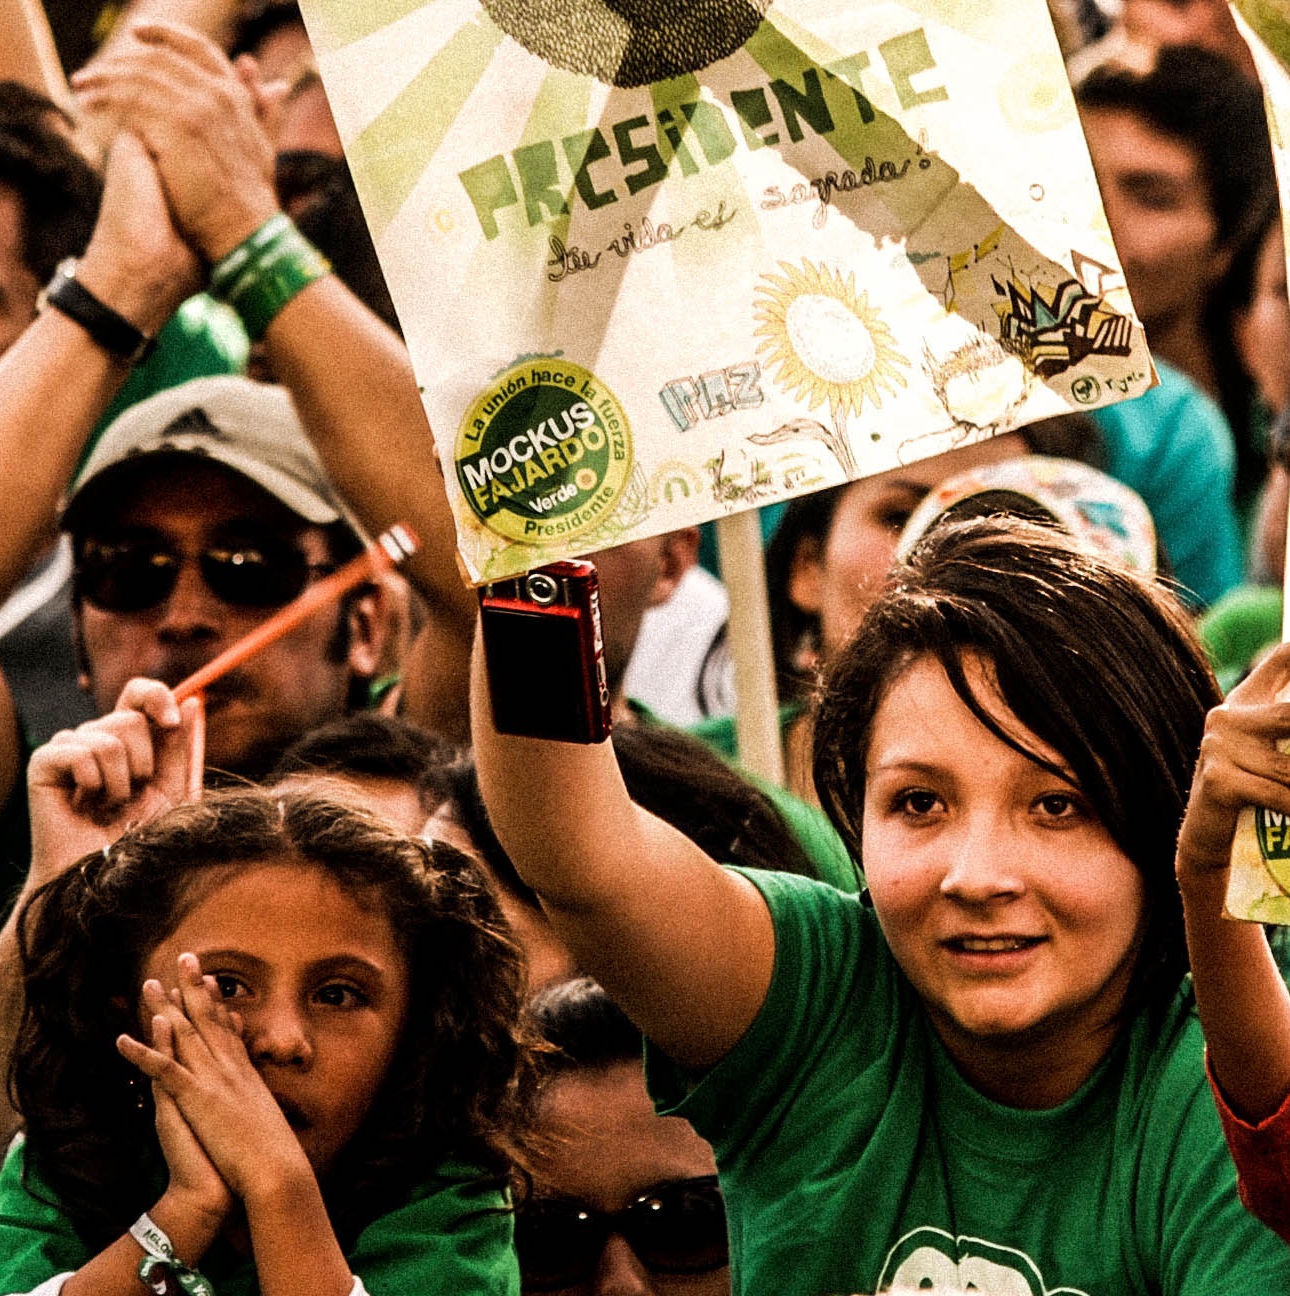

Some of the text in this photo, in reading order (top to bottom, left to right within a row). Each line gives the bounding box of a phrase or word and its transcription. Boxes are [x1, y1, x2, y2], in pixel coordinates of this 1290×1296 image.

[607, 214, 686, 260] vida
[464, 368, 626, 462] La unión hace la fuerza
[659, 360, 765, 433] PAZ
[462, 401, 596, 491] MOCKUS
[472, 424, 607, 513] FAJARDO
[524, 485, 615, 538] Presidente
[528, 480, 580, 515] Verde
